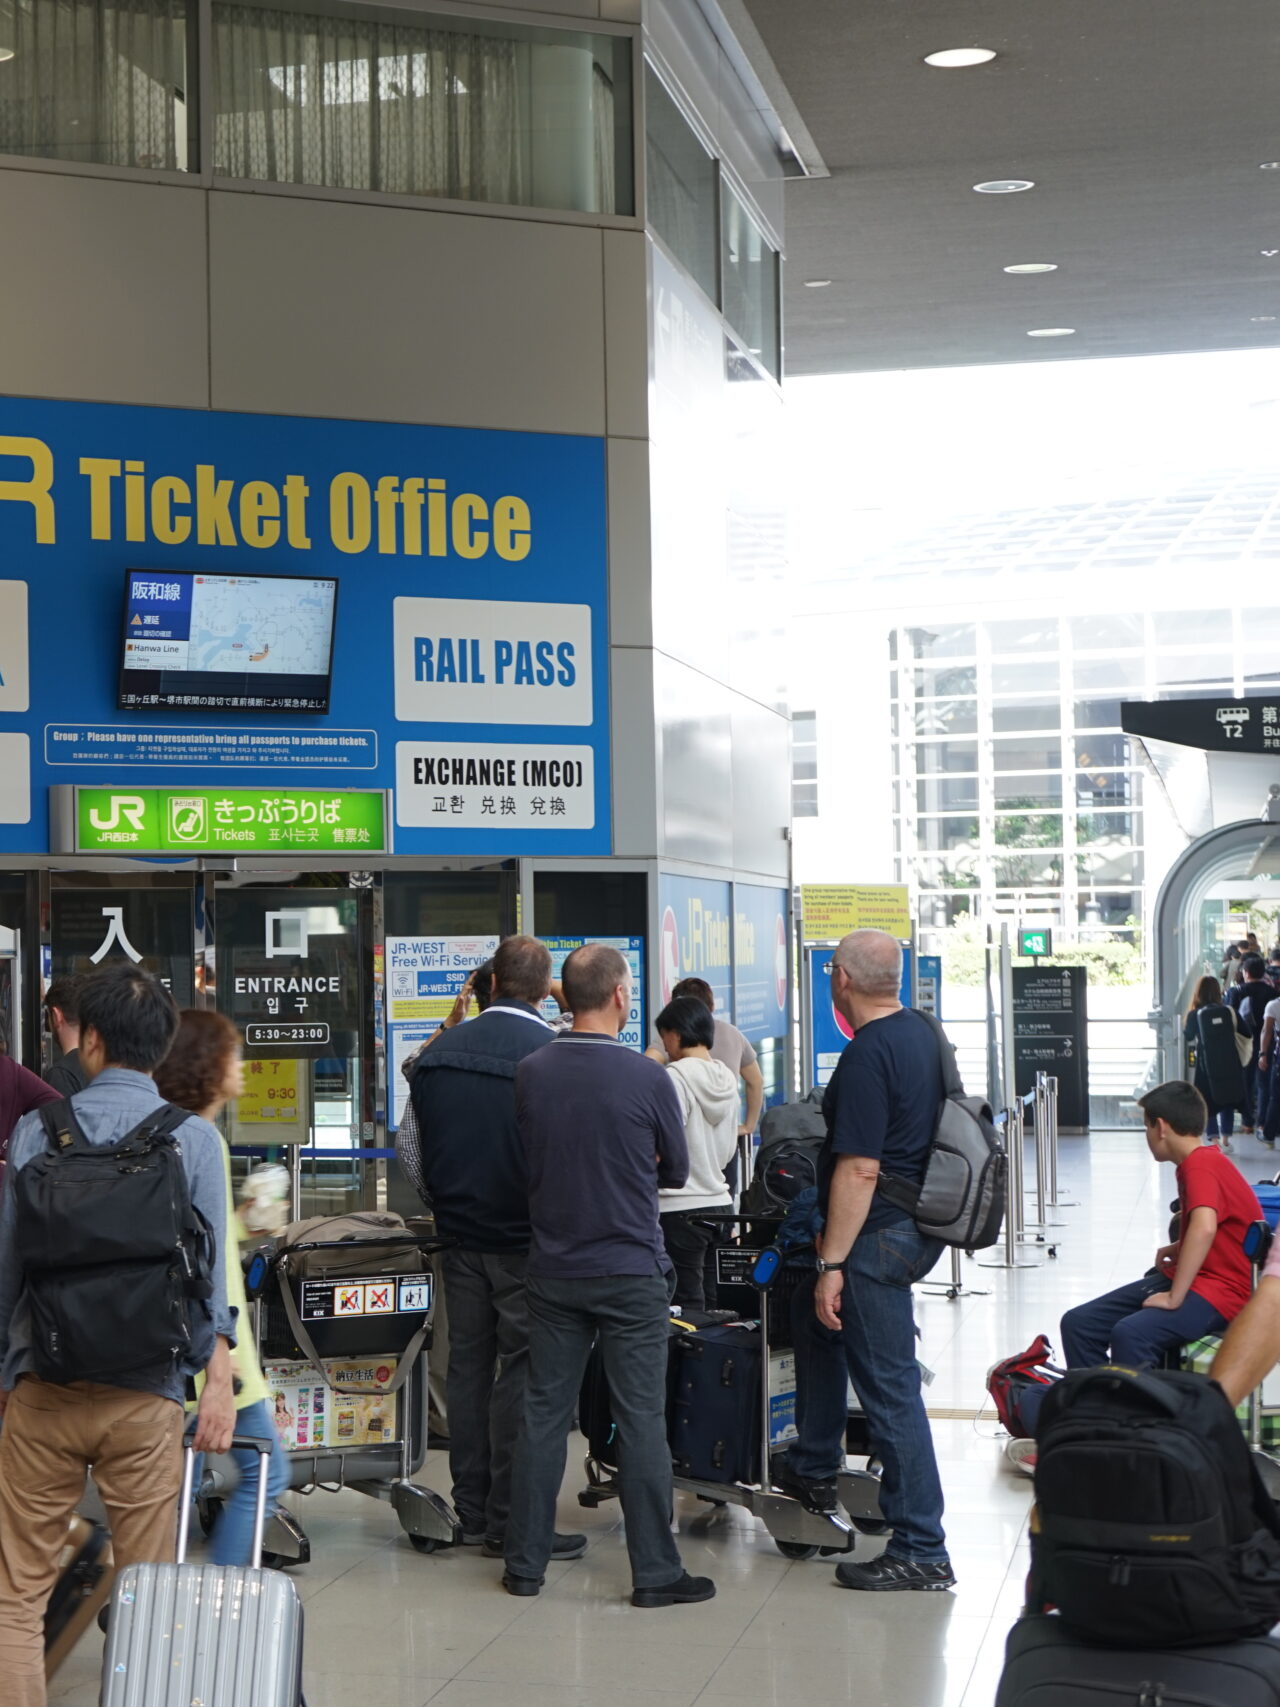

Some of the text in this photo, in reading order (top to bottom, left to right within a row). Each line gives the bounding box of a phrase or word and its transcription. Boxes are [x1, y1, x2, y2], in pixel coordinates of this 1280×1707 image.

[79, 457, 311, 550] Ticket
[329, 471, 531, 561] Office
[132, 581, 180, 601] 阪和線
[135, 644, 179, 653] Hanwa Line
[414, 636, 576, 688] RAIL PASS
[1222, 725, 1243, 738] T2
[53, 731, 369, 747] Group Please have one representative bring all passports to purchase tickets.
[414, 757, 583, 787] EXCHANGE (MCO)
[214, 798, 341, 824] きっぷうりば
[432, 795, 465, 815] 교환
[481, 795, 516, 815] 兑换
[89, 795, 145, 830] JR
[97, 832, 138, 842] JR西日本
[214, 828, 255, 841] Tickets
[268, 828, 320, 842] 표사는곳
[332, 828, 370, 843] 售票处
[682, 898, 704, 972] JR
[391, 942, 445, 954] JR-WEST
[486, 941, 496, 949] JR
[392, 955, 489, 967] Free Wi-Fi Servic
[446, 973, 465, 982] SSID
[235, 977, 340, 993] ENTRANCE
[394, 988, 413, 996] Wi-Fi
[267, 1087, 296, 1099] 9:30
[335, 1368, 373, 1382] 納豆生活
